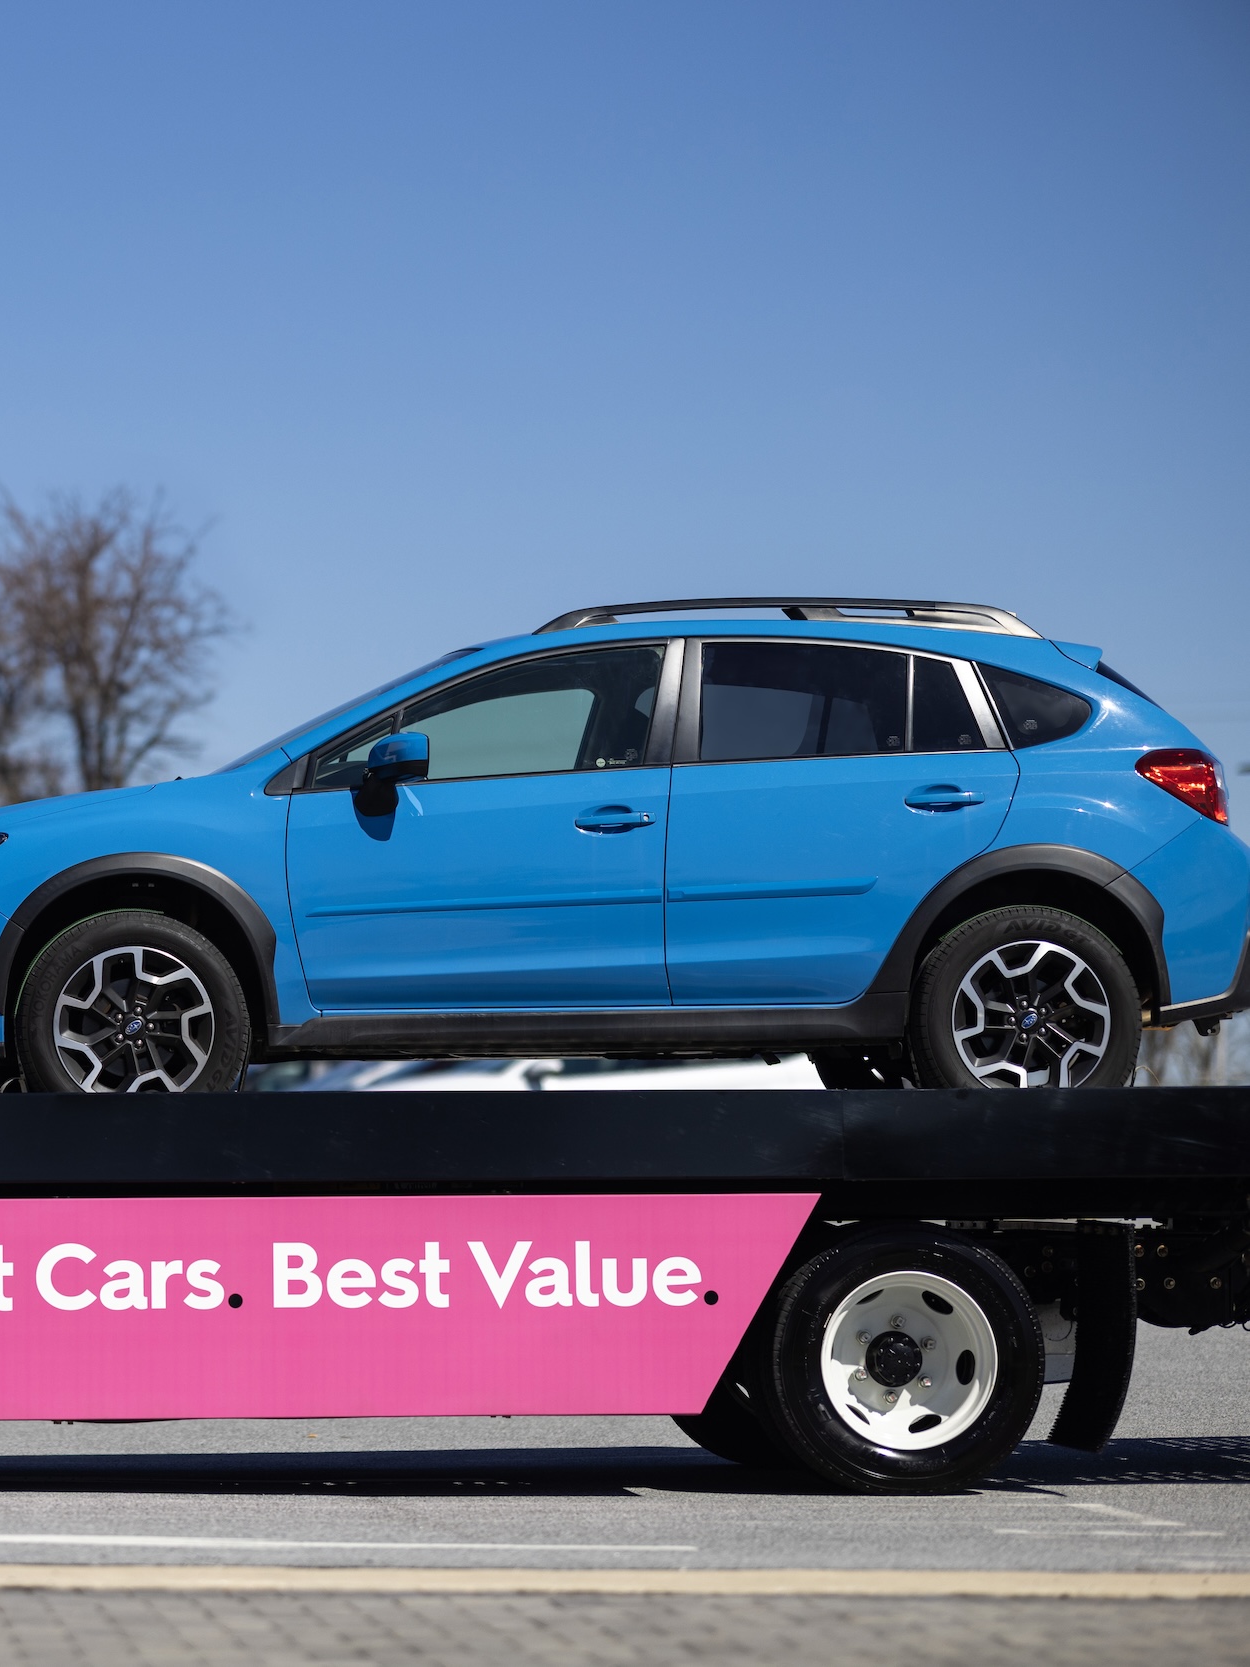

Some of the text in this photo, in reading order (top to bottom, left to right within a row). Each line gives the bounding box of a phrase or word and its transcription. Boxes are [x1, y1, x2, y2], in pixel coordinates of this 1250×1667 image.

[30, 945, 81, 1018] YOKOHAMA
[36, 1243, 243, 1310] Cars.
[273, 1242, 449, 1308] Best
[467, 1241, 719, 1308] Value.
